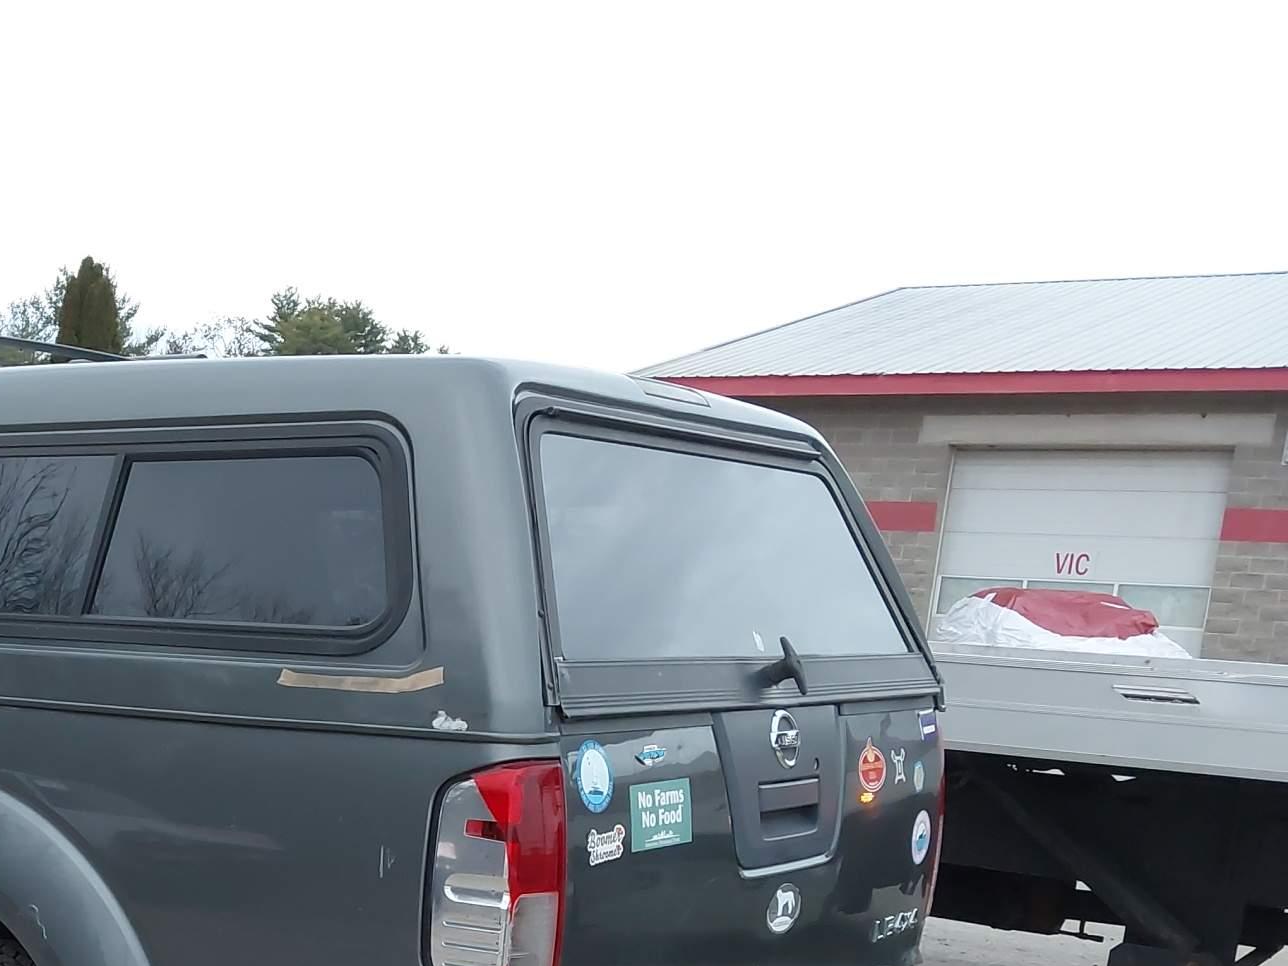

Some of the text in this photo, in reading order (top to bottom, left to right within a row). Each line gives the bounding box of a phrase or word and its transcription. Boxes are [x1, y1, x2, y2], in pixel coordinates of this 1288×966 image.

[1055, 553, 1090, 576] VIC
[638, 789, 684, 808] No Farms
[642, 805, 683, 828] No Food
